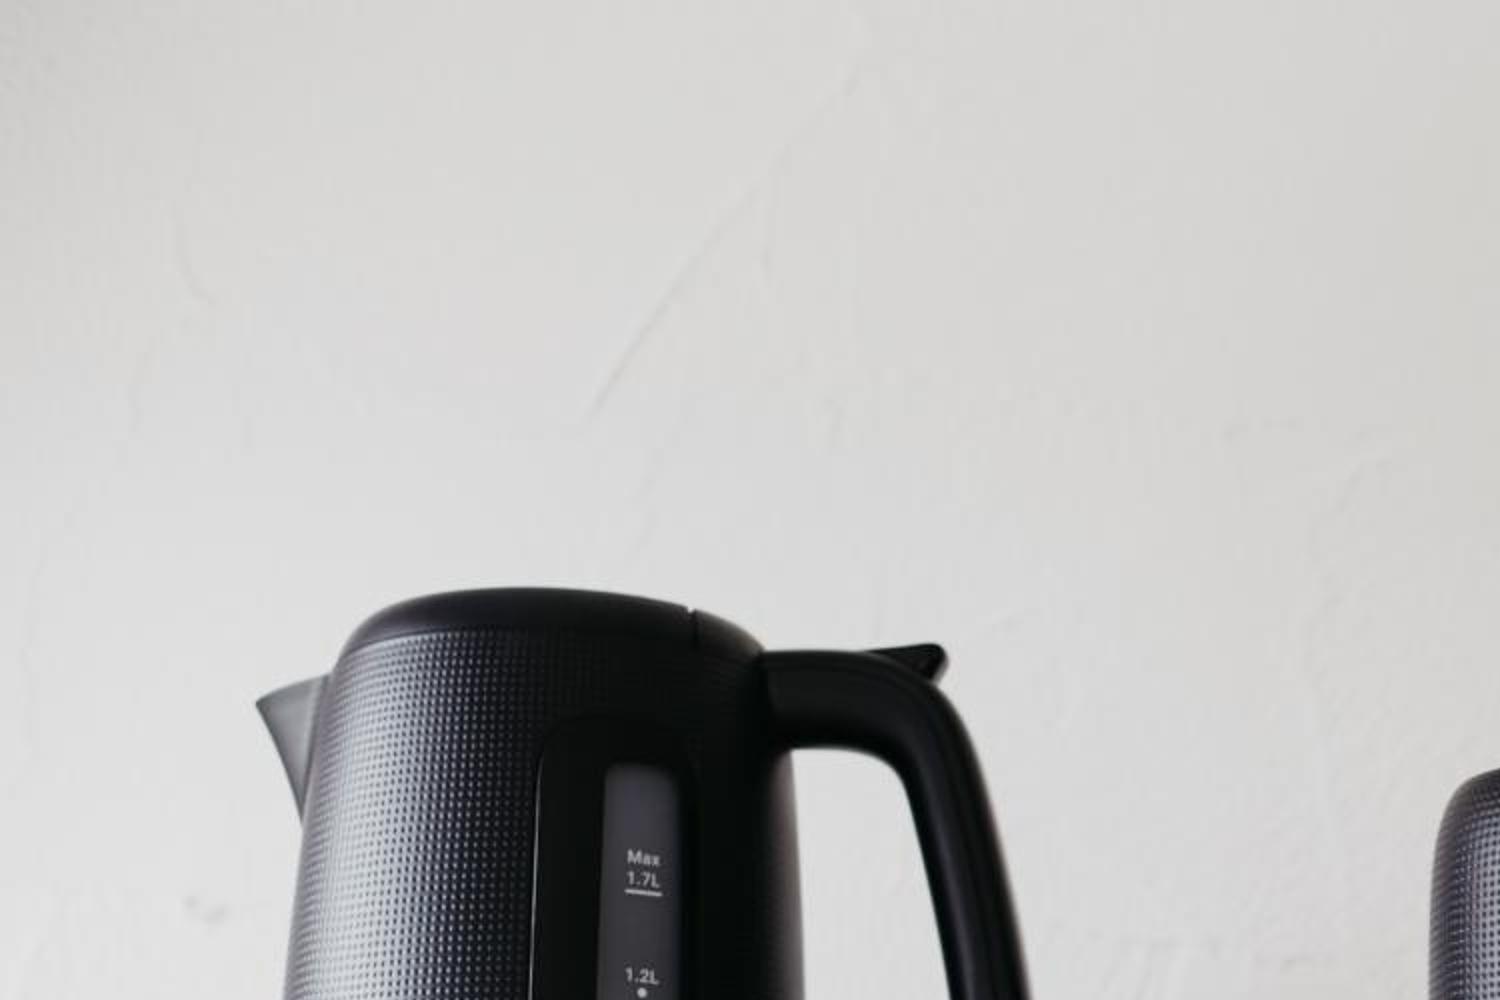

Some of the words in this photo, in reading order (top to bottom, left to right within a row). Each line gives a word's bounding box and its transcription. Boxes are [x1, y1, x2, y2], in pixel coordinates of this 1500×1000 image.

[627, 849, 660, 867] Max
[626, 870, 660, 888] 1.7L
[625, 967, 660, 985] 1.2L
